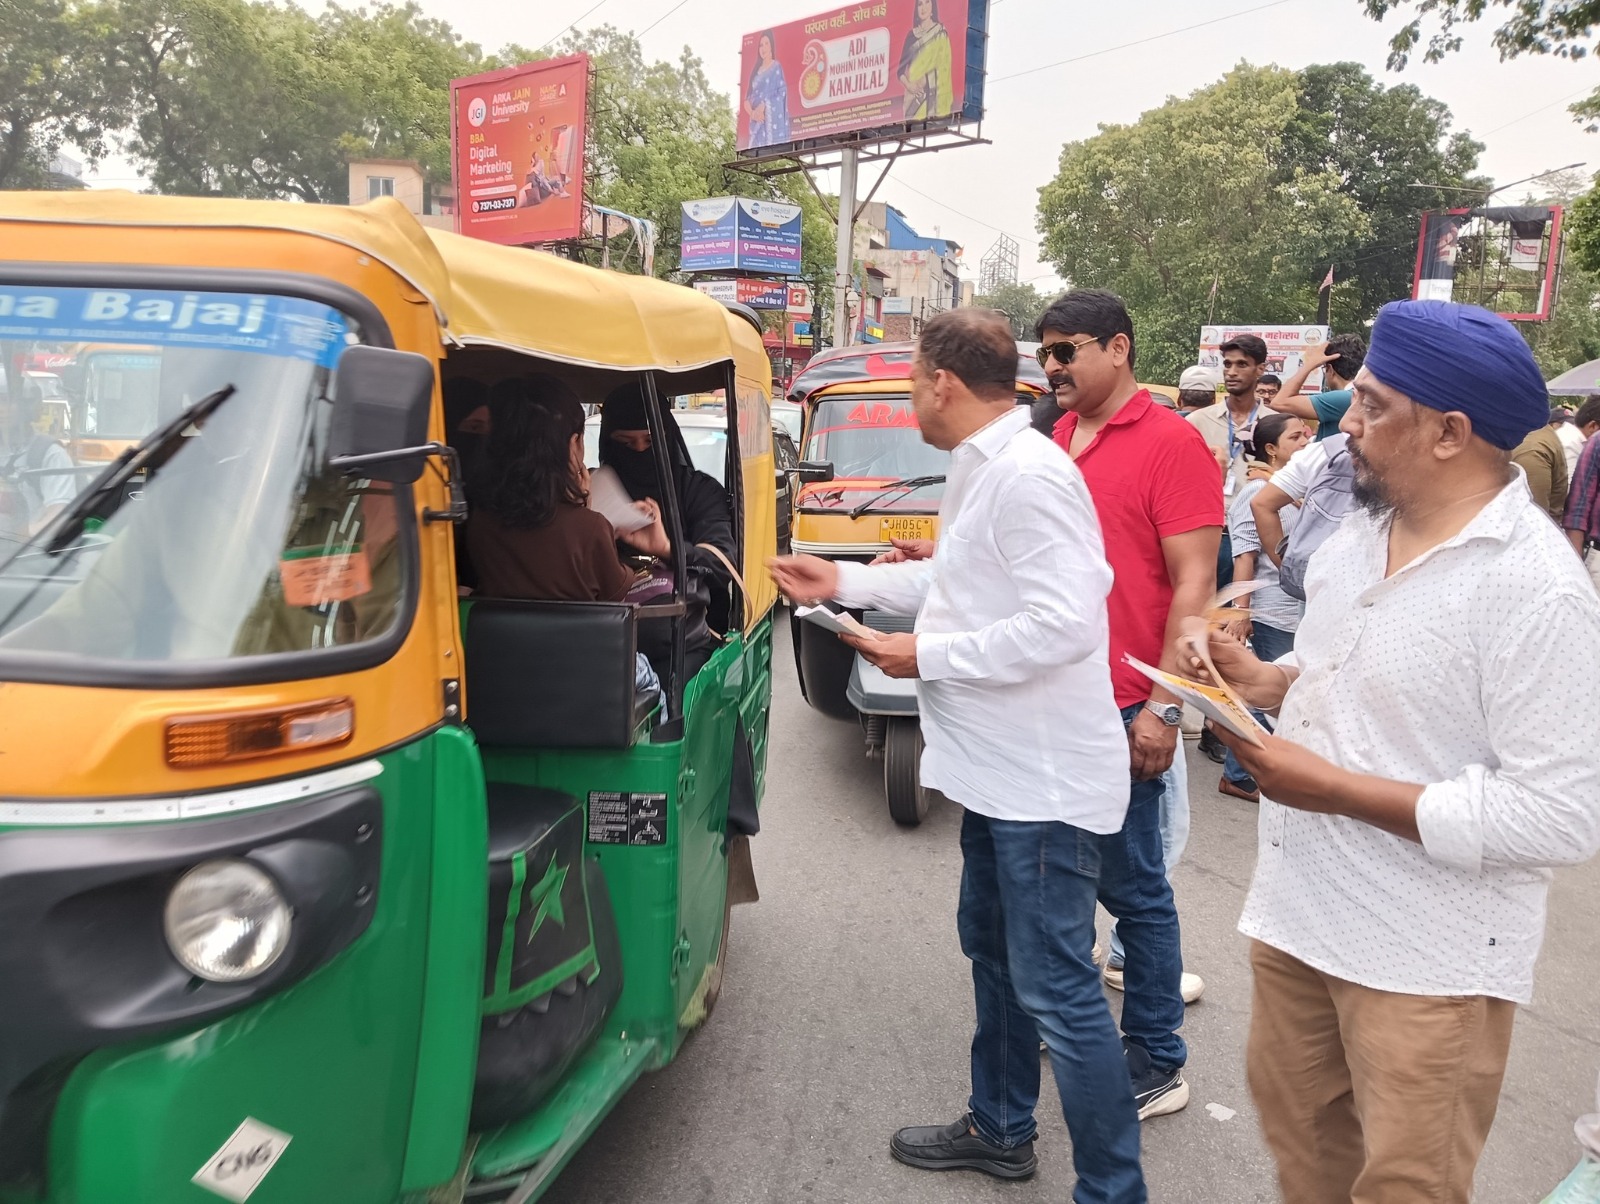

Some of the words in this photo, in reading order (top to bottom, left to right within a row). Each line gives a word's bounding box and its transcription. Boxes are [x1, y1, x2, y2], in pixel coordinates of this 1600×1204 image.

[805, 18, 828, 34] परंपरा
[853, 6, 871, 22] सोच
[872, 0, 886, 16] नई
[848, 37, 866, 57] ADI
[830, 58, 856, 76] MOHINI
[858, 53, 885, 69] MOHAN
[559, 84, 566, 96] A
[829, 70, 884, 97] KANJILAL
[492, 92, 511, 104] ARKA
[513, 87, 530, 100] JAIN
[472, 108, 483, 119] JGI
[492, 100, 530, 116] University
[470, 133, 484, 144] BBA
[470, 144, 497, 161] Digital
[470, 160, 512, 176] Marketing
[480, 198, 514, 211] 7371-03-7371
[745, 295, 756, 303] 112
[82, 291, 268, 334] Bajaj
[1265, 330, 1300, 340] महोत्सव
[890, 519, 922, 530] JH05C
[214, 1138, 274, 1180] CNG
